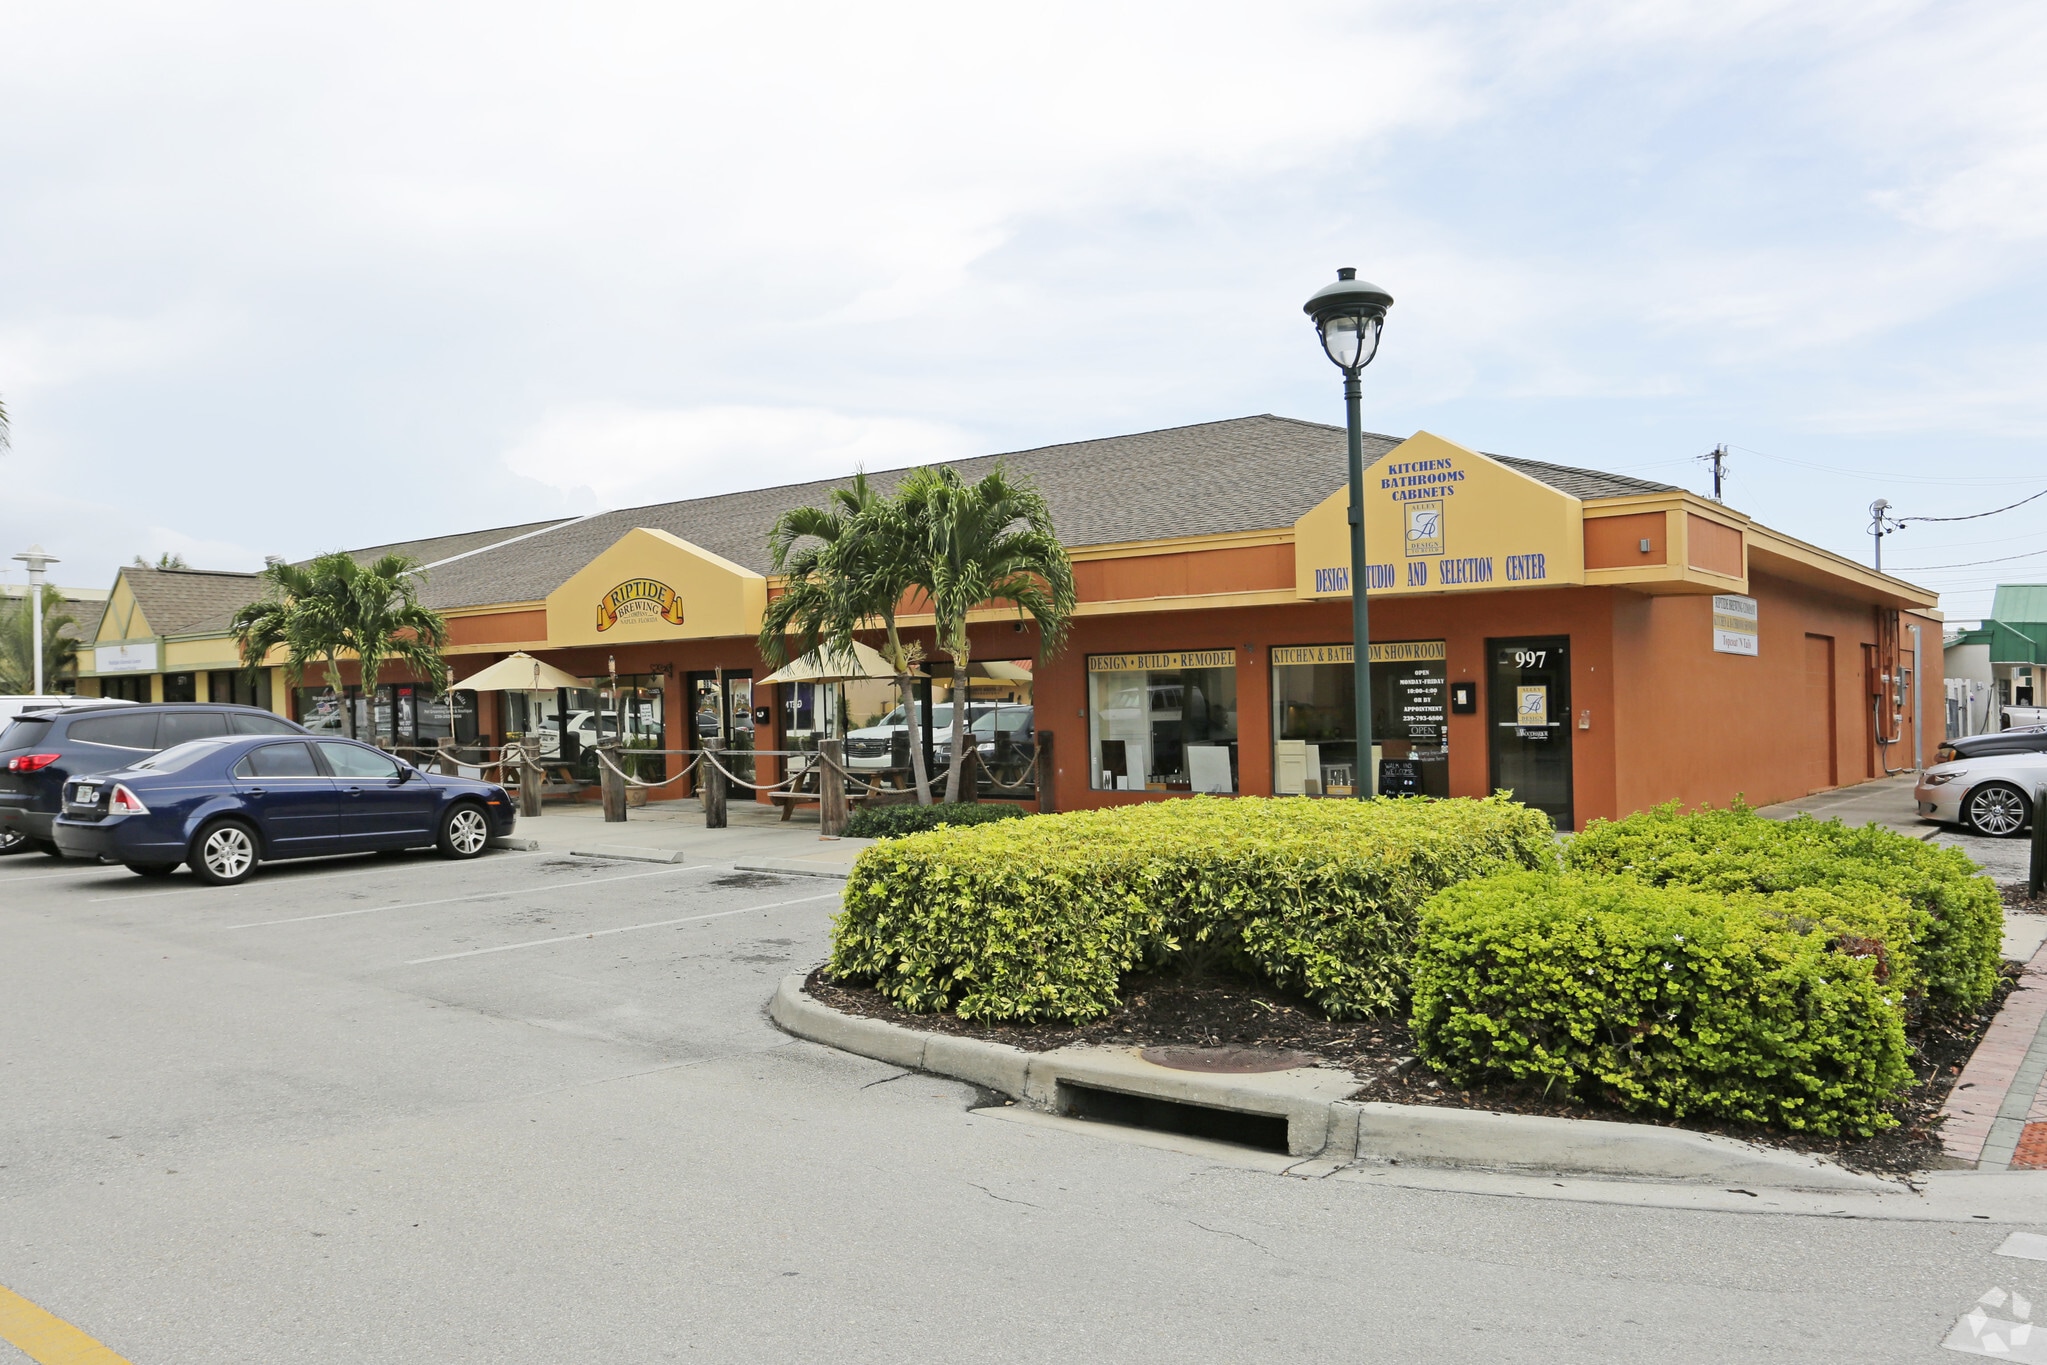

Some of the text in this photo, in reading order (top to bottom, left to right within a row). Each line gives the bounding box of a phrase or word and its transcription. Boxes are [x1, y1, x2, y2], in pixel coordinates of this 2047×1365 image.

[1389, 458, 1452, 475] KITCHENS
[1381, 470, 1465, 489] BATHROOMS
[1392, 485, 1454, 501] CABINETS
[1315, 553, 1546, 592] DESIGN TUDIO AND SELECTION CENTER
[611, 581, 667, 606] RIPTIDE
[618, 601, 659, 617] BREWING
[1090, 651, 1234, 670] DESIGN BUILD REMODEL
[1274, 647, 1314, 663] KITCHEN
[1318, 648, 1325, 661] &
[1385, 643, 1444, 660] SHOWROOM
[1515, 651, 1546, 668] 997
[1411, 727, 1435, 735] OPEN
